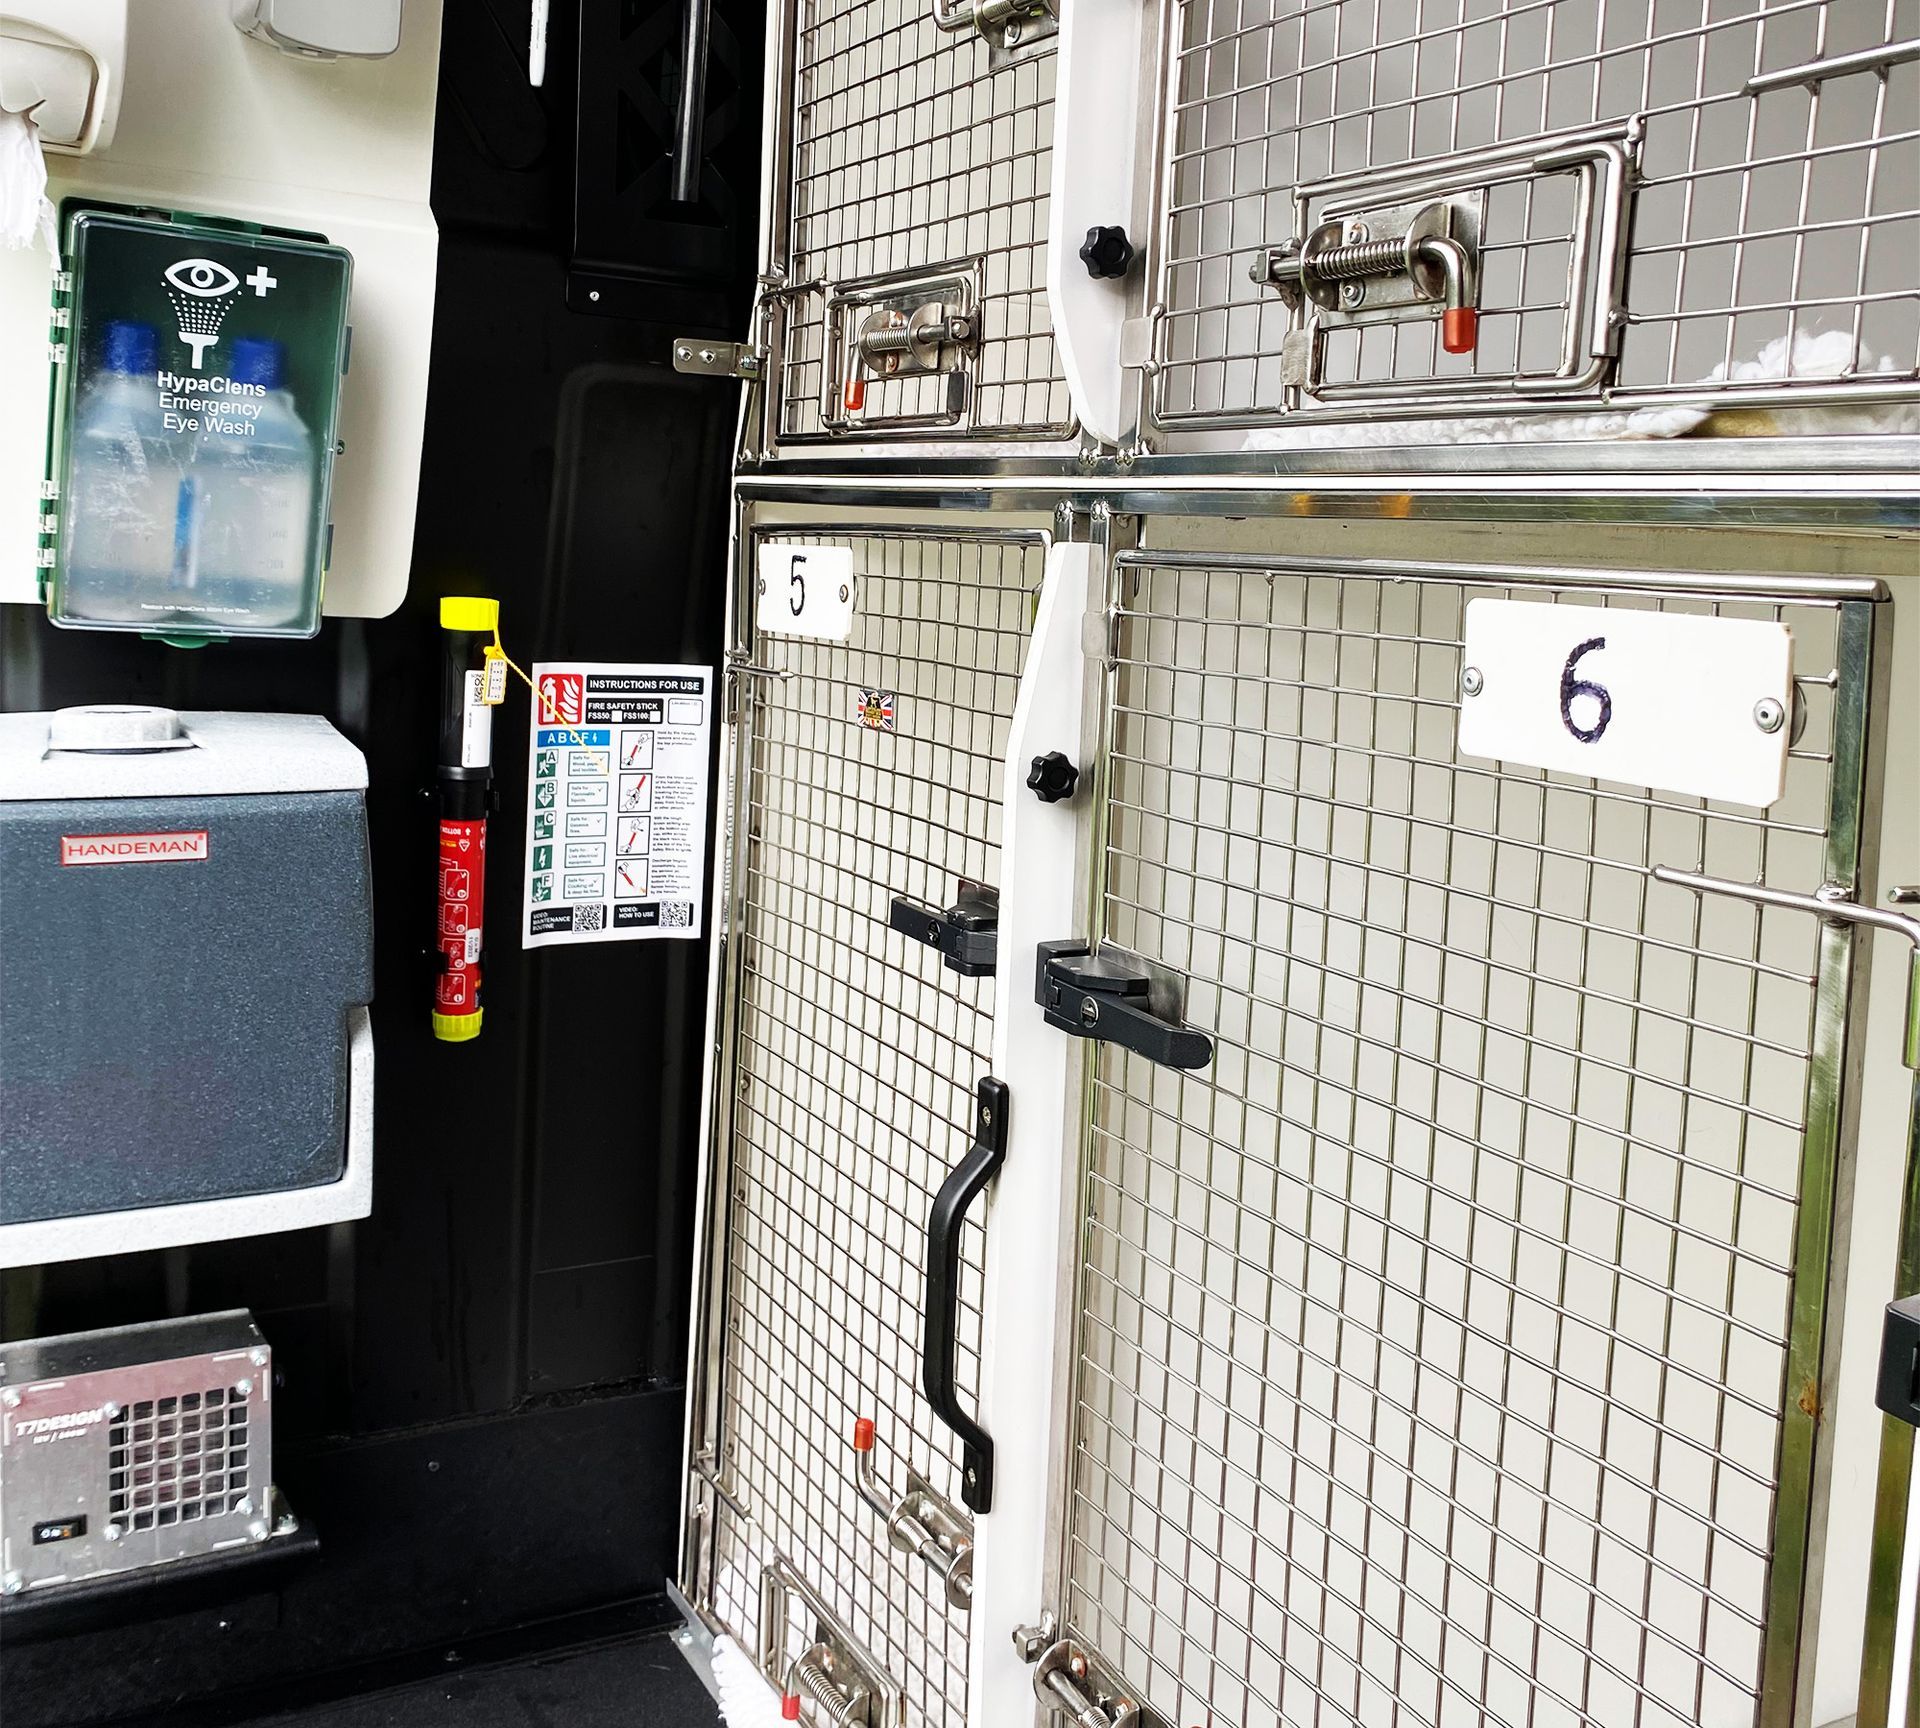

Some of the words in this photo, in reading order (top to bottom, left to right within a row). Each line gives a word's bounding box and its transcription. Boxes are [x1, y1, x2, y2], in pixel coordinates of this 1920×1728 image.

[157, 369, 266, 398] HypaClens
[159, 391, 263, 420] Emergency
[163, 412, 200, 434] Eye
[204, 416, 255, 436] Wash
[789, 554, 807, 616] 5
[590, 680, 657, 689] INSTRUCTIONS
[659, 680, 679, 690] FOR
[680, 682, 700, 691] USE
[1560, 637, 1612, 744] 6
[588, 702, 606, 710] FIRE
[606, 702, 635, 710] SAFETY
[636, 702, 658, 710] STICK
[548, 752, 556, 762] A
[547, 782, 555, 793] B
[546, 813, 554, 824] C
[68, 841, 198, 857] HANDEMAN
[544, 875, 550, 886] F
[15, 1408, 104, 1436] T7DESIGN
